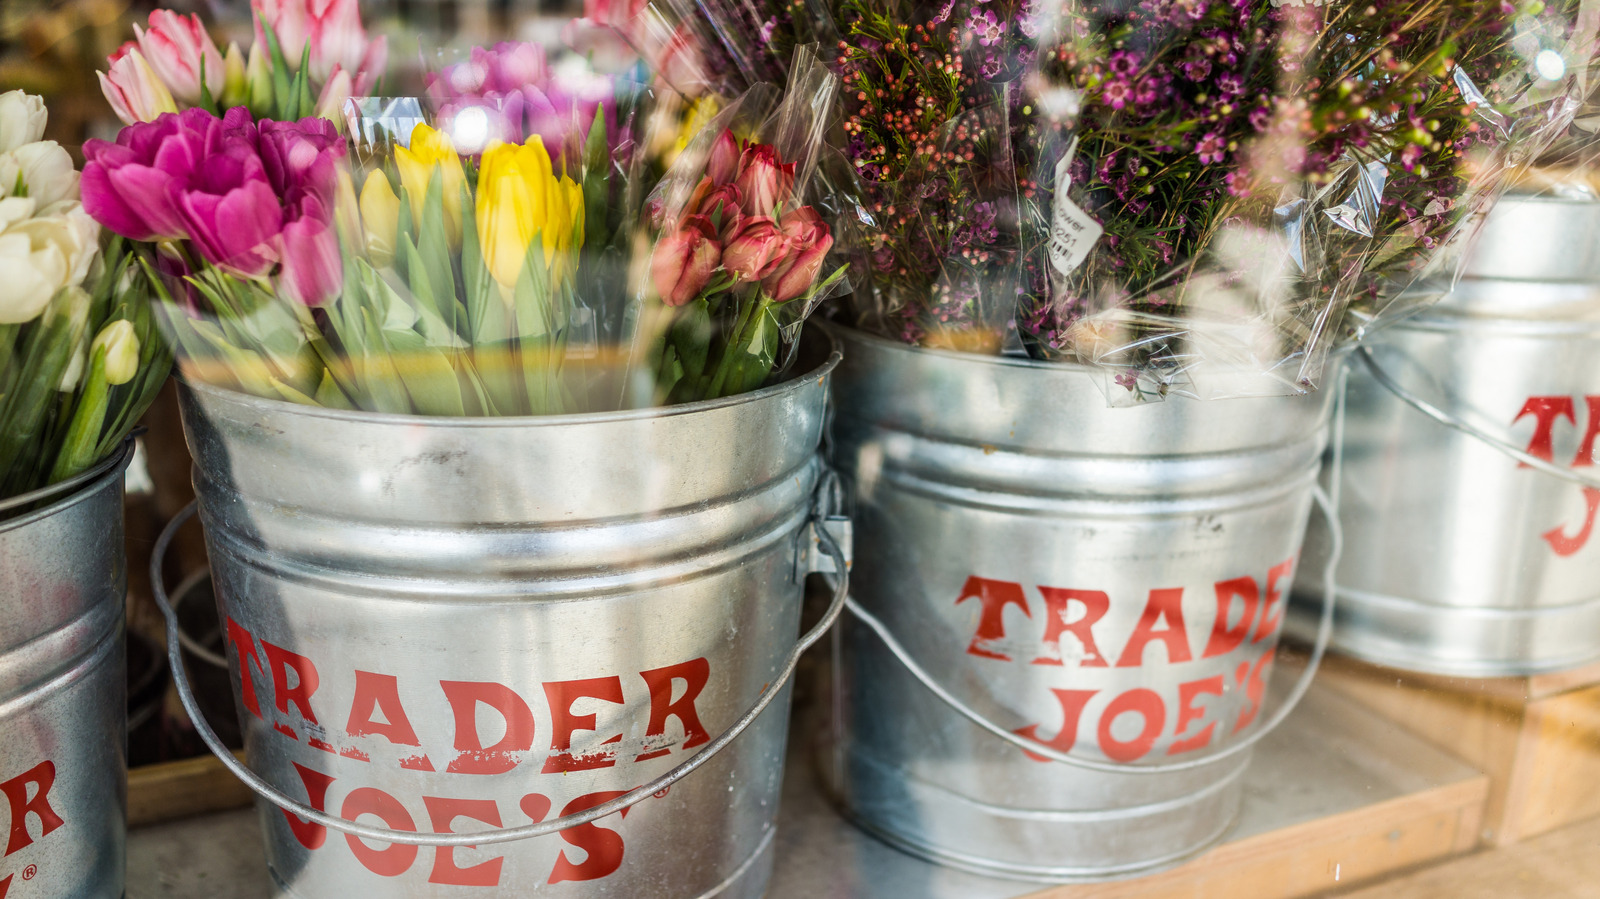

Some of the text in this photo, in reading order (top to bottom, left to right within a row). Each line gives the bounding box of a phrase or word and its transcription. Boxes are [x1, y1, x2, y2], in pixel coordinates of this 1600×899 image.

[227, 615, 710, 775] TRADER
[1012, 647, 1275, 763] JOE'S
[280, 760, 643, 886] JOE'S
